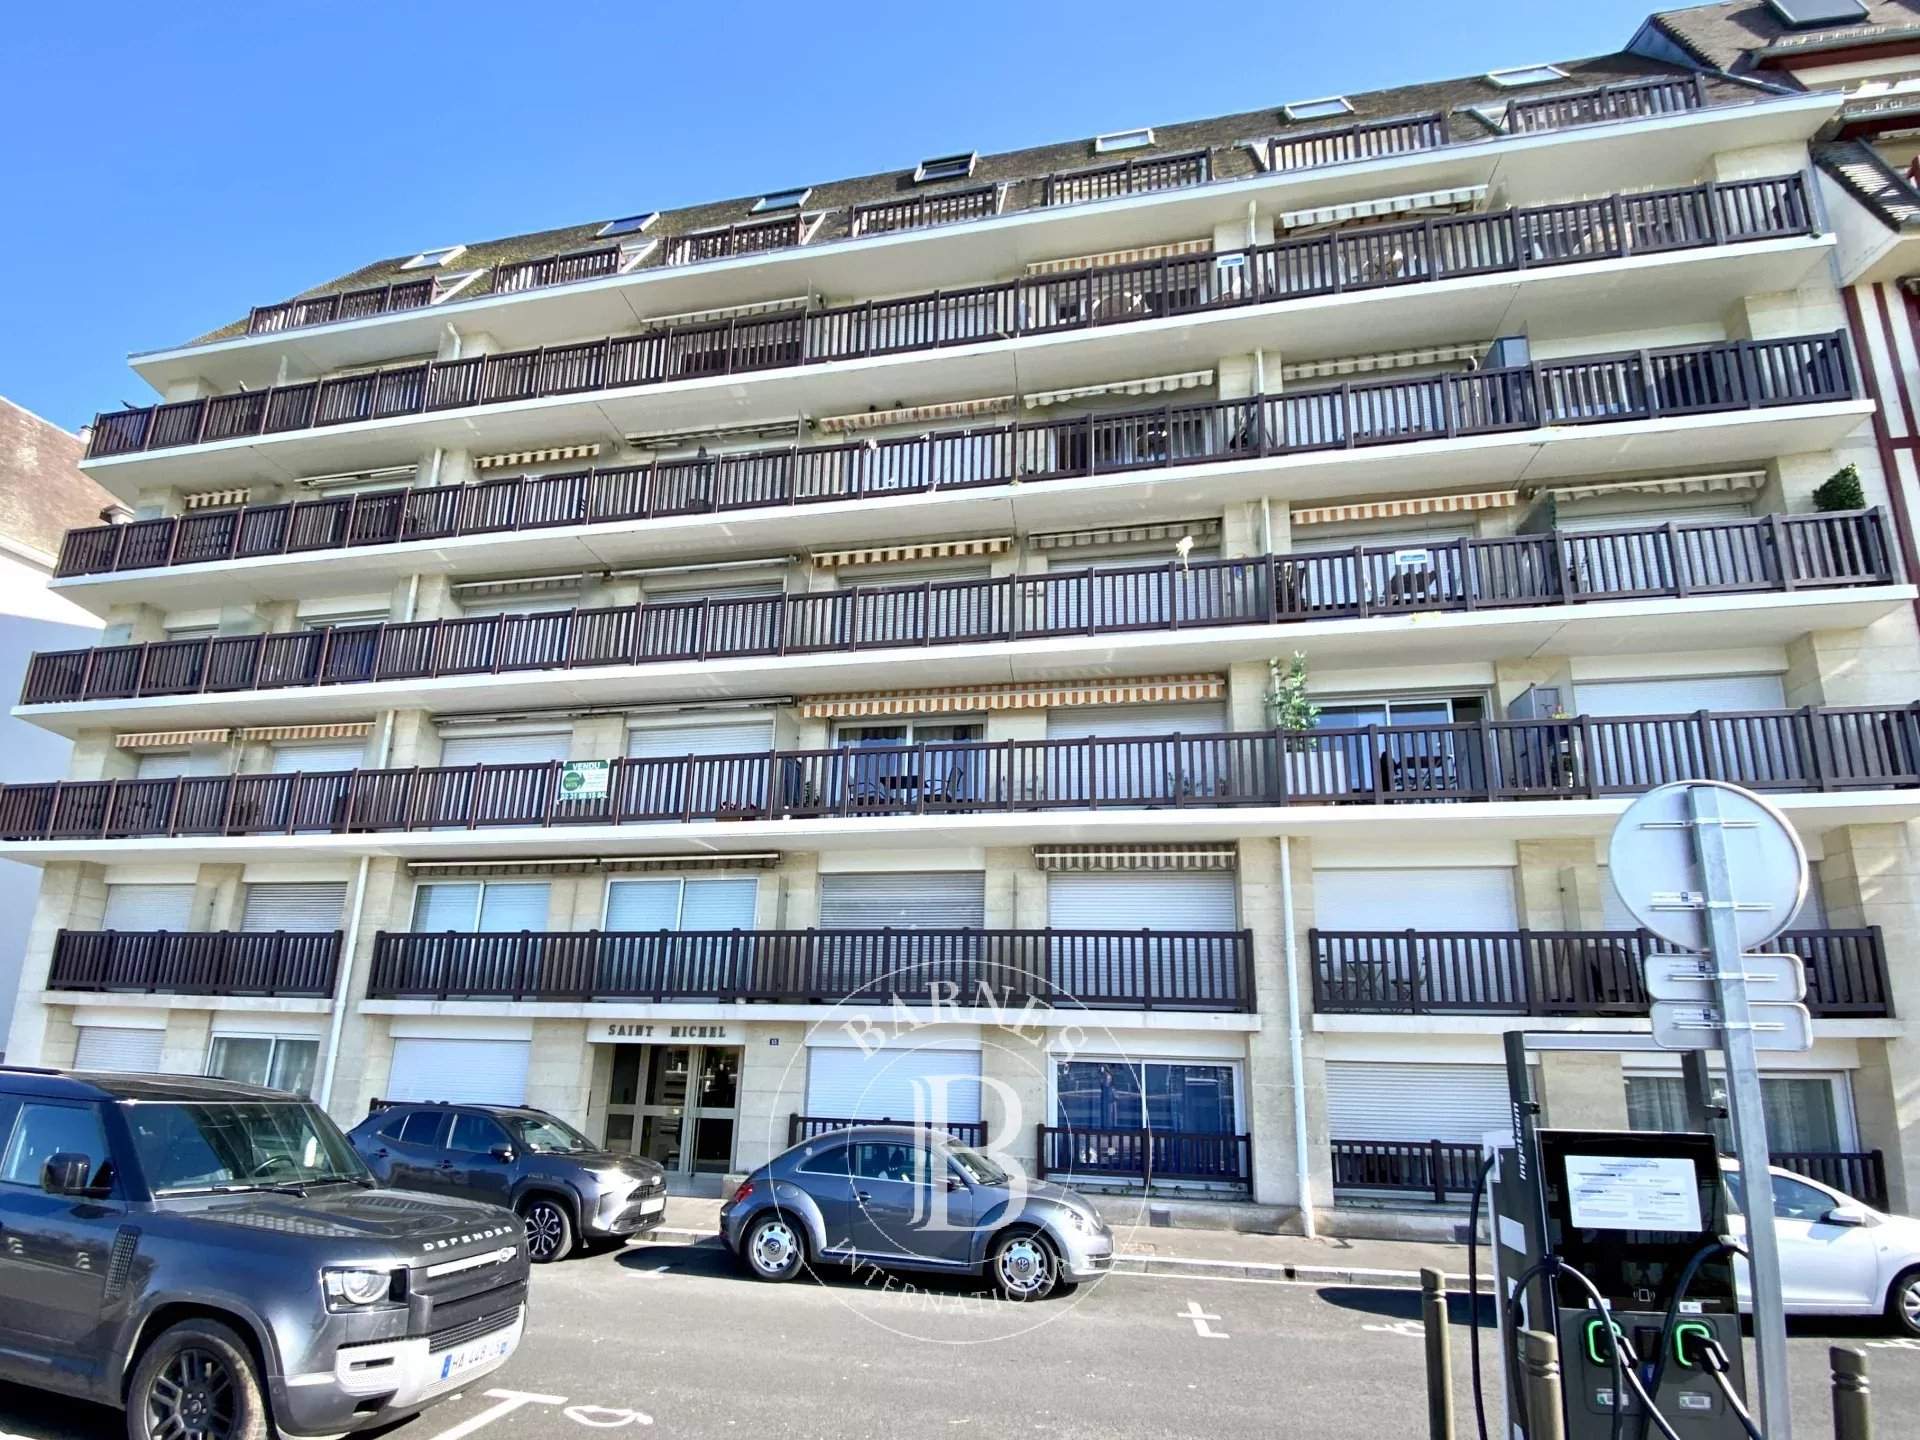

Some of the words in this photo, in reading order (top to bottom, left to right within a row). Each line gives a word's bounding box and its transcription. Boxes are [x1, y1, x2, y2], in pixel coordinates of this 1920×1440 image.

[572, 762, 601, 770] VENDU
[608, 1024, 654, 1037] SAINT
[670, 1025, 726, 1038] MICHEL
[1513, 1102, 1527, 1180] Ingeteam
[423, 1226, 512, 1251] DEFENDER
